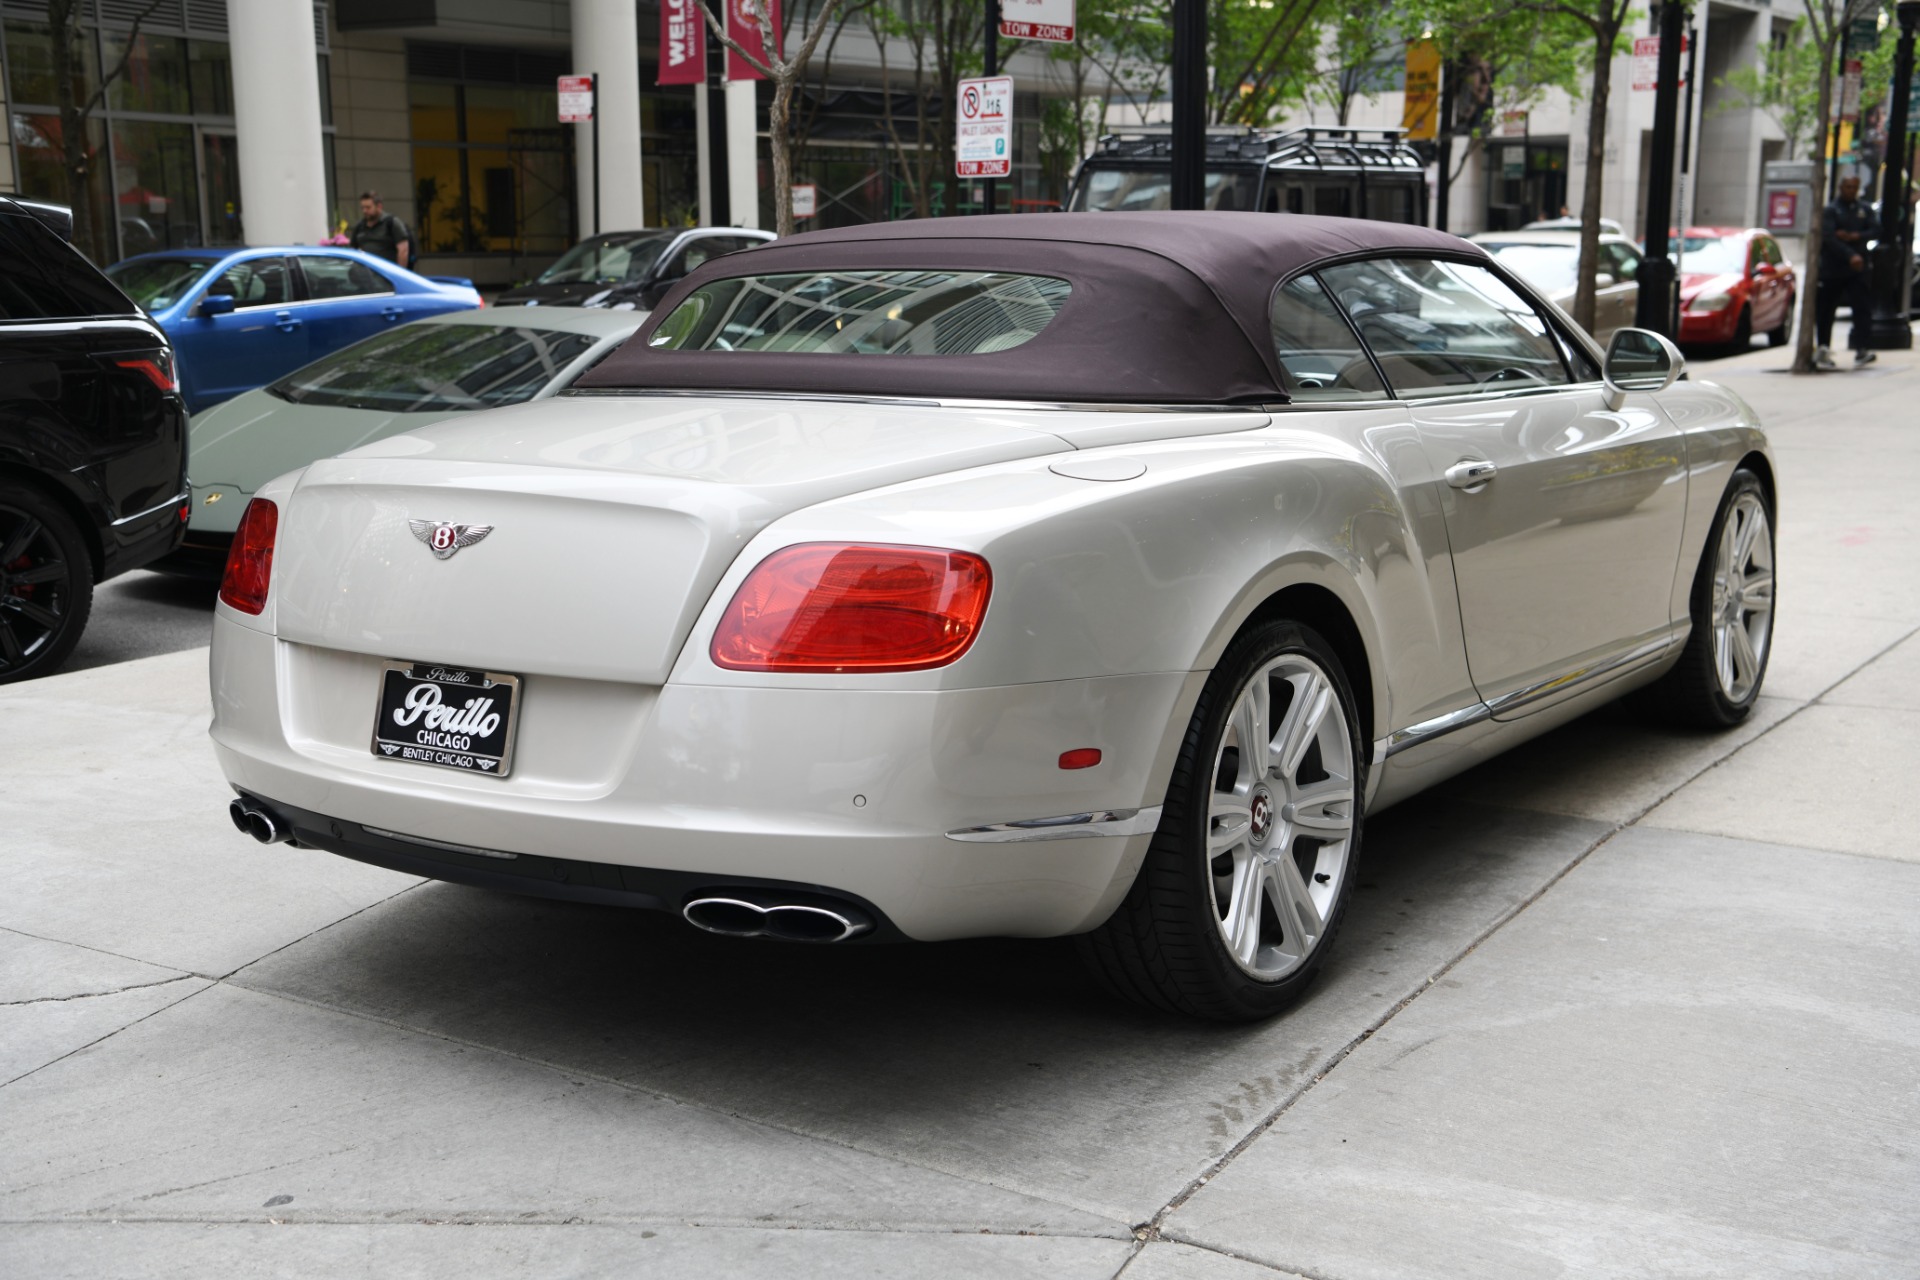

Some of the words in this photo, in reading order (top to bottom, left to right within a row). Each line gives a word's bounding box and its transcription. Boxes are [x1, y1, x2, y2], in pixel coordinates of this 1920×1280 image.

[1004, 22, 1031, 36] TOW
[1036, 25, 1068, 40] ZONE
[961, 126, 978, 136] VALET
[980, 124, 1005, 135] LOADING
[961, 162, 978, 174] TOW
[981, 161, 1005, 174] ZONE
[433, 526, 451, 548] B
[426, 667, 470, 683] Perillo
[393, 683, 500, 738] Perillo
[416, 729, 471, 750] CHICAGO
[402, 747, 435, 761] BENTLEY
[435, 752, 474, 768] CHICAGO
